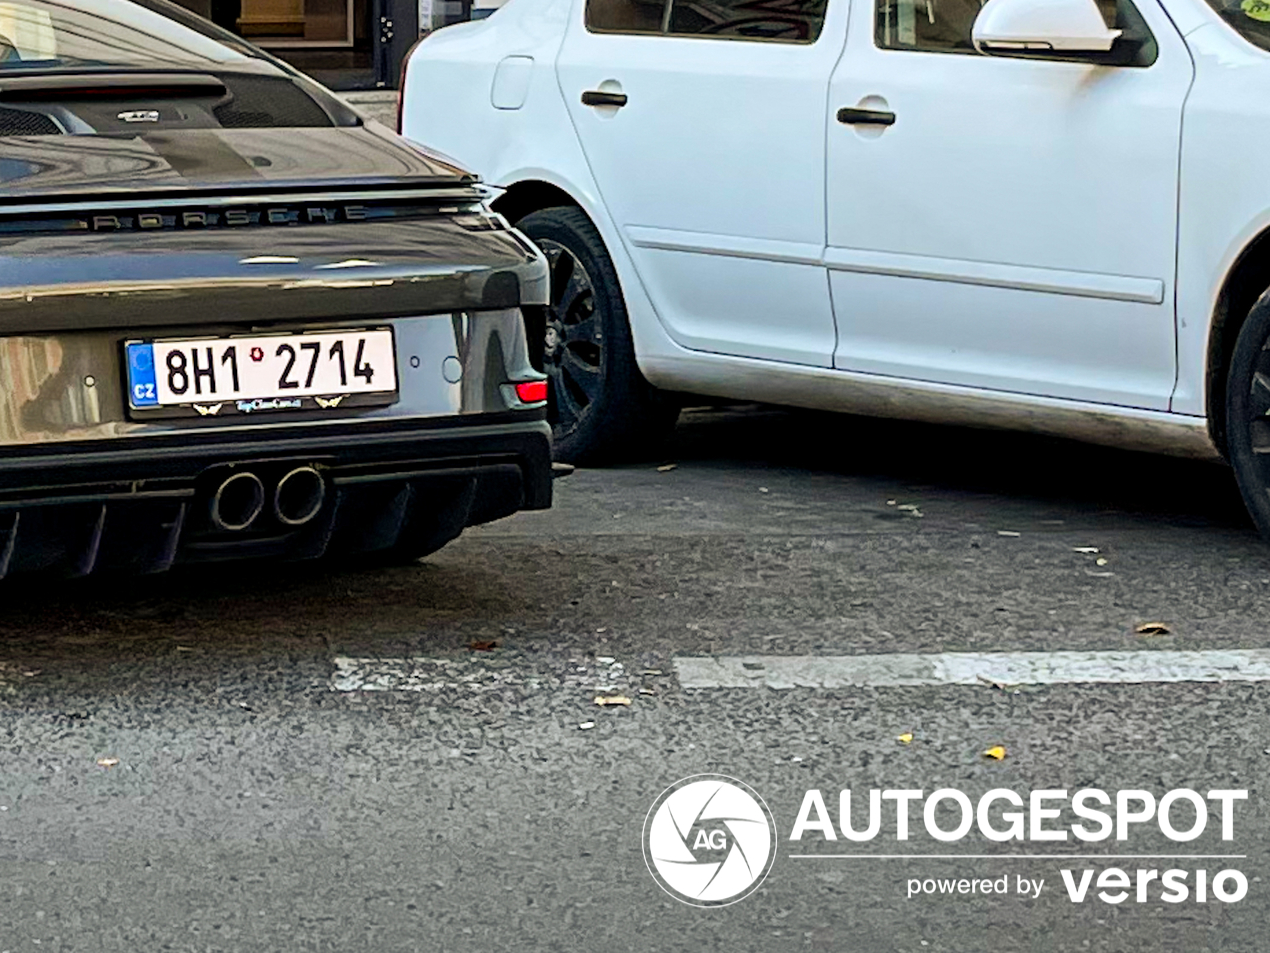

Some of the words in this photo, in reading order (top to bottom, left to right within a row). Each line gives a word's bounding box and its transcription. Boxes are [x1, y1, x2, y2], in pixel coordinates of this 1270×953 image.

[92, 205, 366, 231] PORSCHE
[165, 346, 240, 395] 8H1
[275, 338, 374, 389] 2714
[134, 383, 155, 400] CZ
